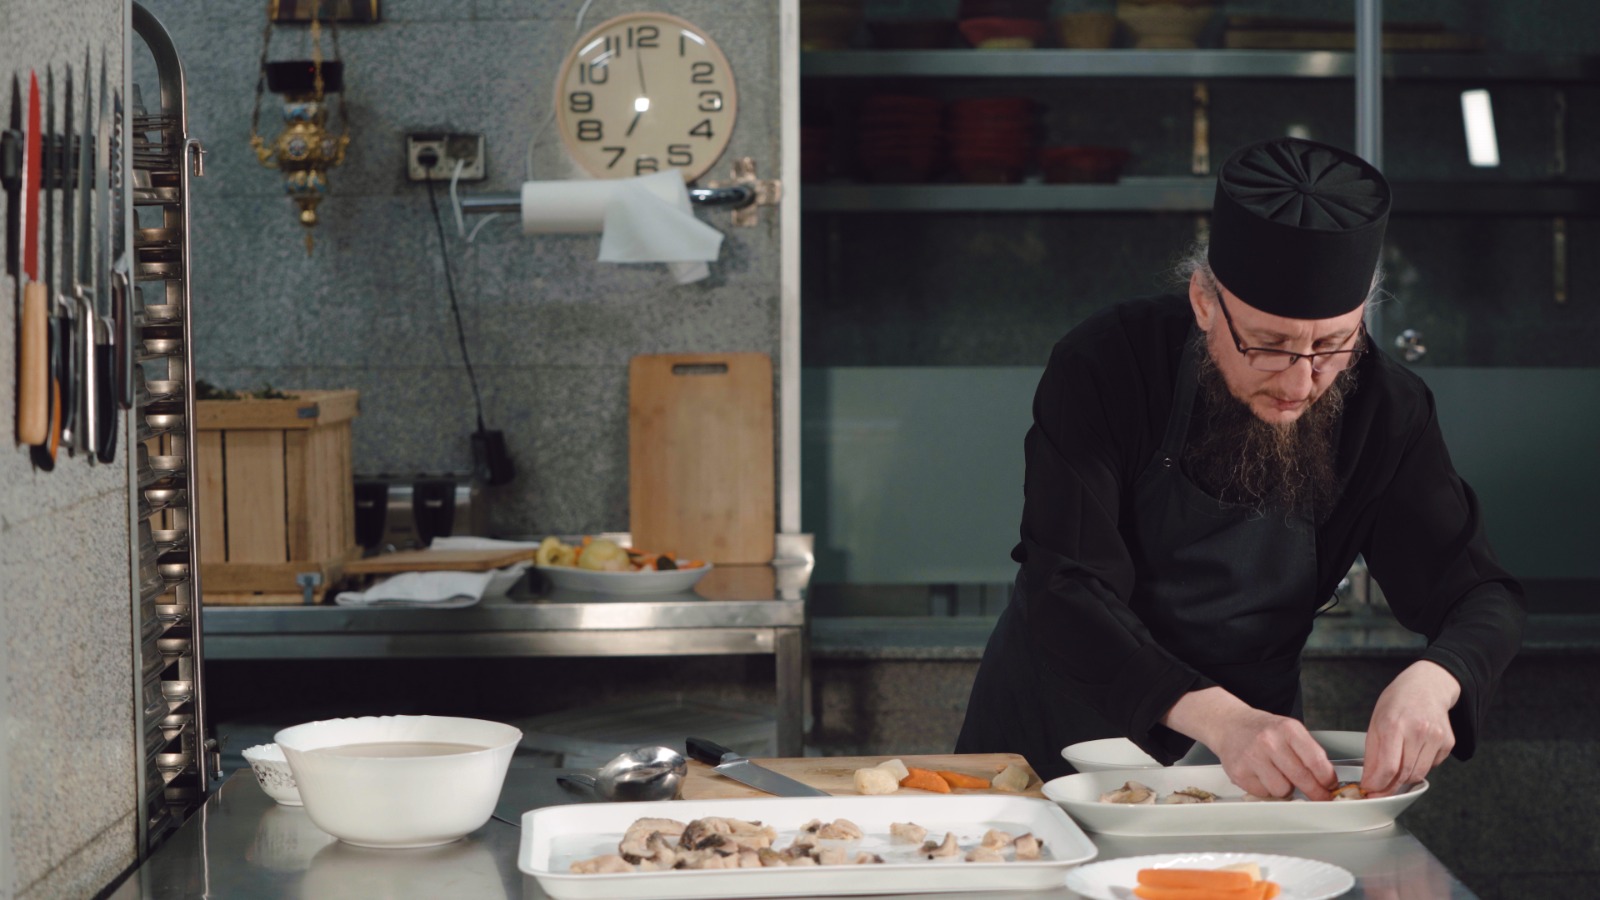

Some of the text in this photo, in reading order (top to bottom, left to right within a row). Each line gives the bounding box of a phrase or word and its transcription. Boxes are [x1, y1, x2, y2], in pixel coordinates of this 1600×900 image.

[604, 35, 621, 58] 11
[628, 26, 660, 48] 12
[679, 32, 686, 57] 1
[579, 62, 608, 85] 10
[691, 61, 714, 84] 2
[569, 91, 593, 113] 9
[698, 90, 723, 112] 3
[577, 119, 603, 142] 8
[688, 118, 714, 140] 4
[602, 146, 626, 169] 7
[634, 157, 659, 176] 6
[667, 144, 693, 167] 5
